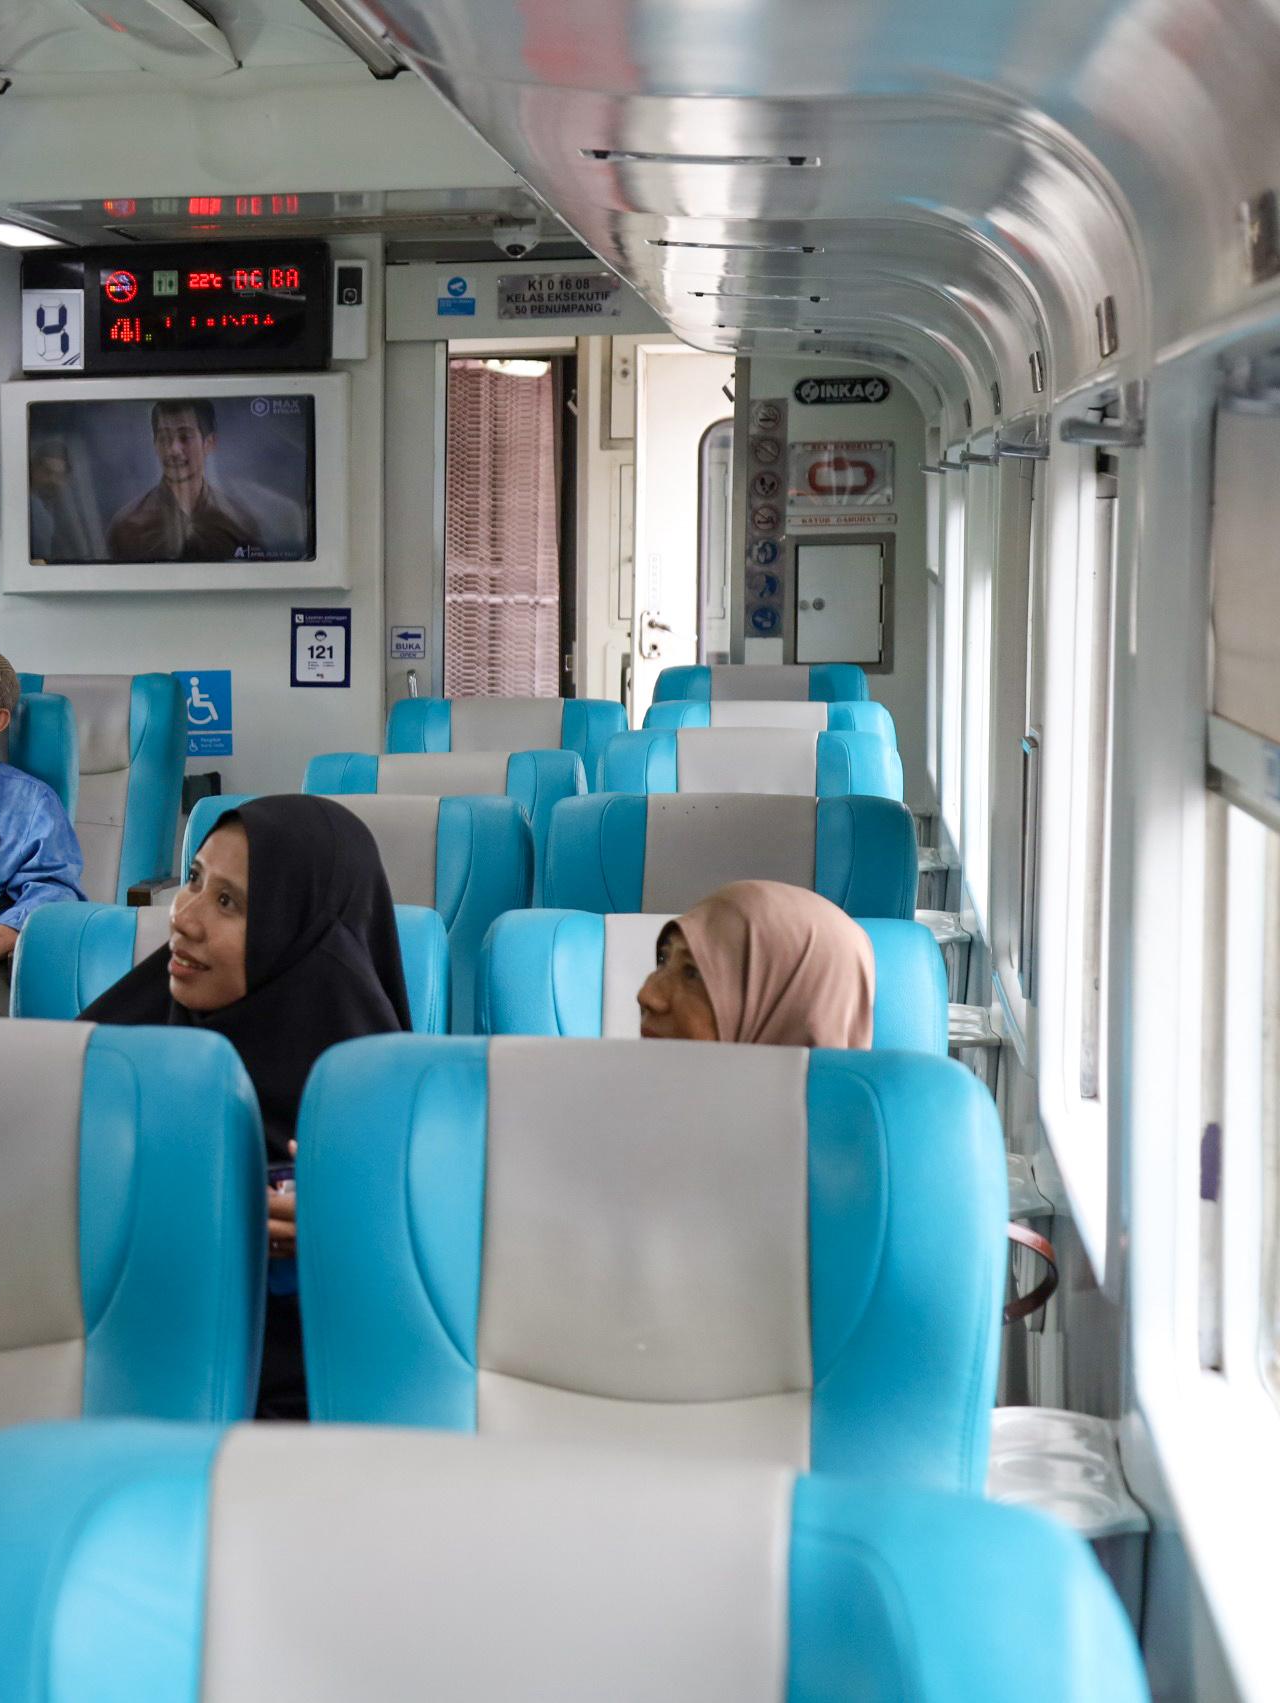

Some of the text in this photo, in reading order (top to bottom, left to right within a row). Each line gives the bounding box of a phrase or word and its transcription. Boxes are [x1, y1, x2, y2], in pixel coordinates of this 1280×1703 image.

[235, 269, 263, 289] DC
[271, 268, 299, 288] BA
[506, 291, 611, 303] KELAS EKSEKUTIF
[515, 303, 602, 314] 50 PENUMPANG
[820, 384, 865, 398] INKA
[308, 645, 334, 659] 121
